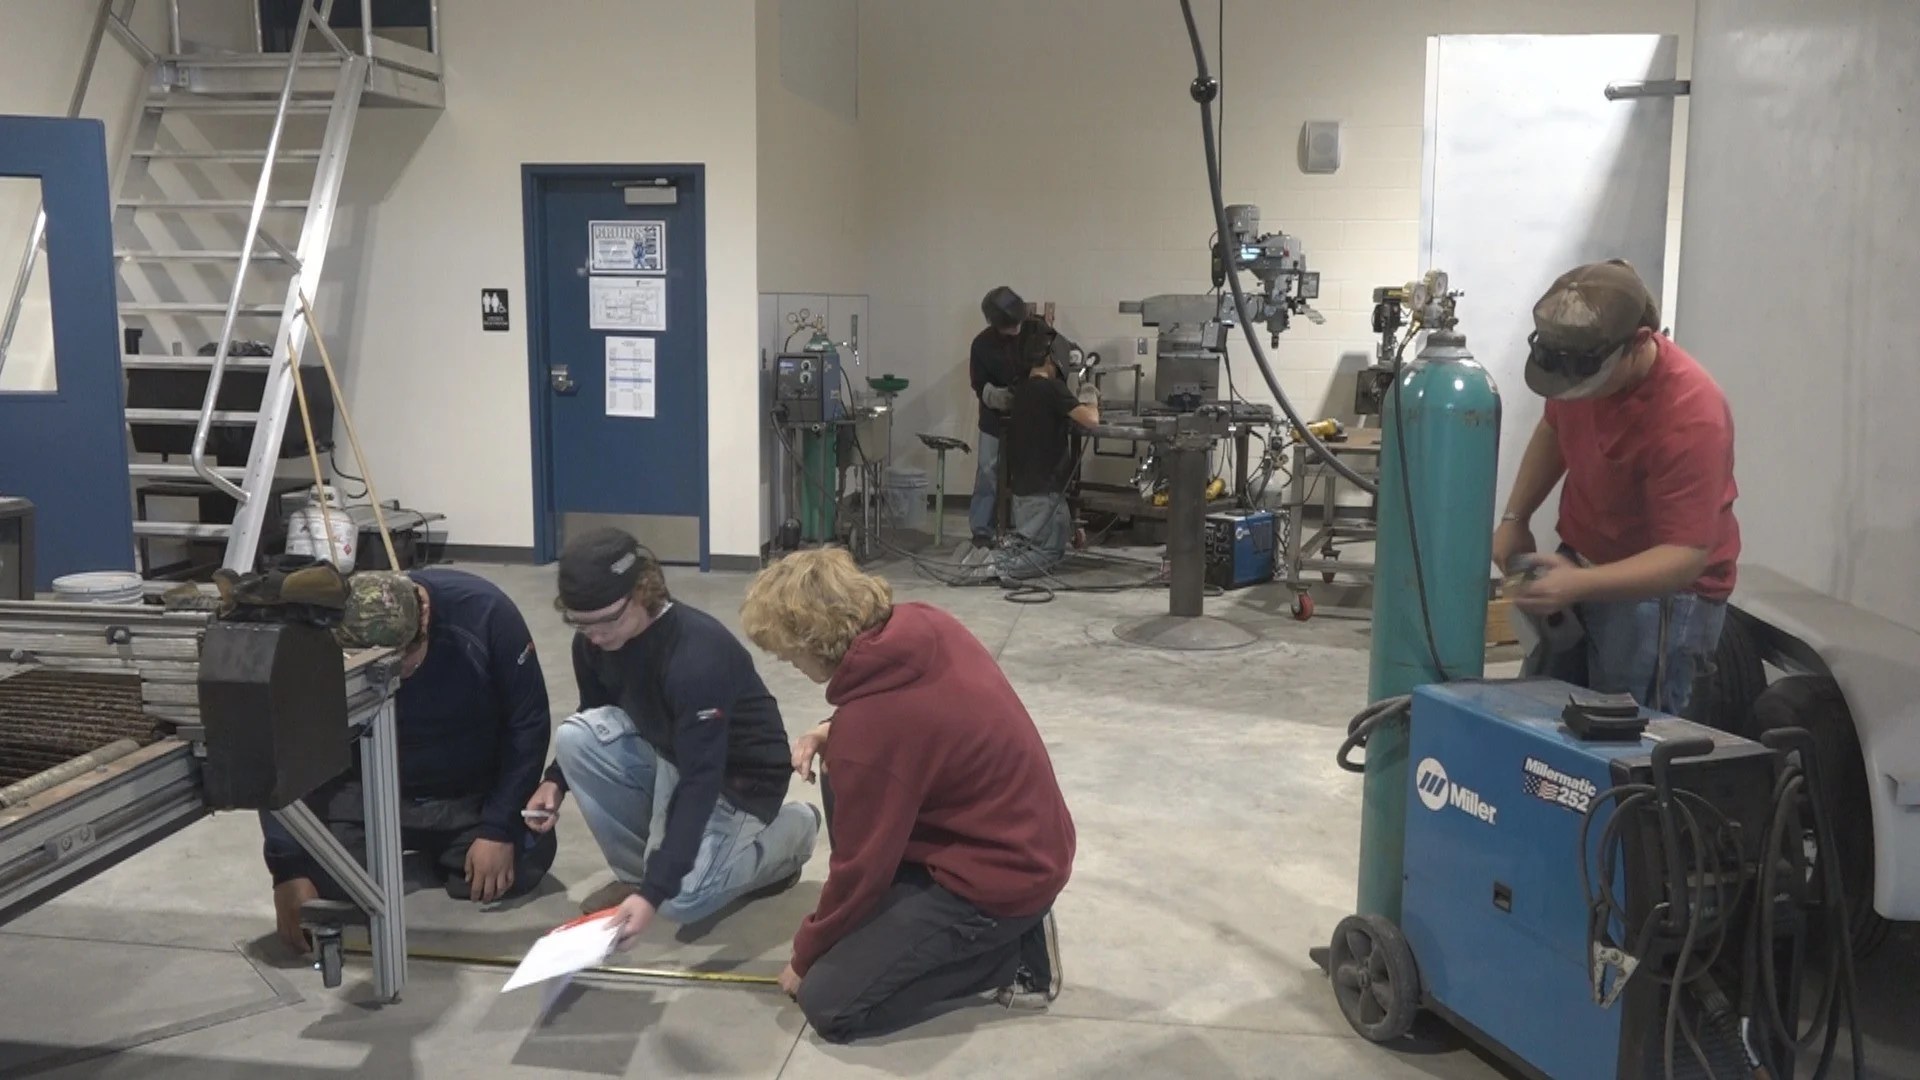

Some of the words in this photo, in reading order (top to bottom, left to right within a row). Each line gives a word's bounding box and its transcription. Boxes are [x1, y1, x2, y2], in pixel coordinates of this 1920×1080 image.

[1525, 757, 1596, 796] Millermatic
[1450, 782, 1497, 825] Miller
[1557, 787, 1590, 812] 252
